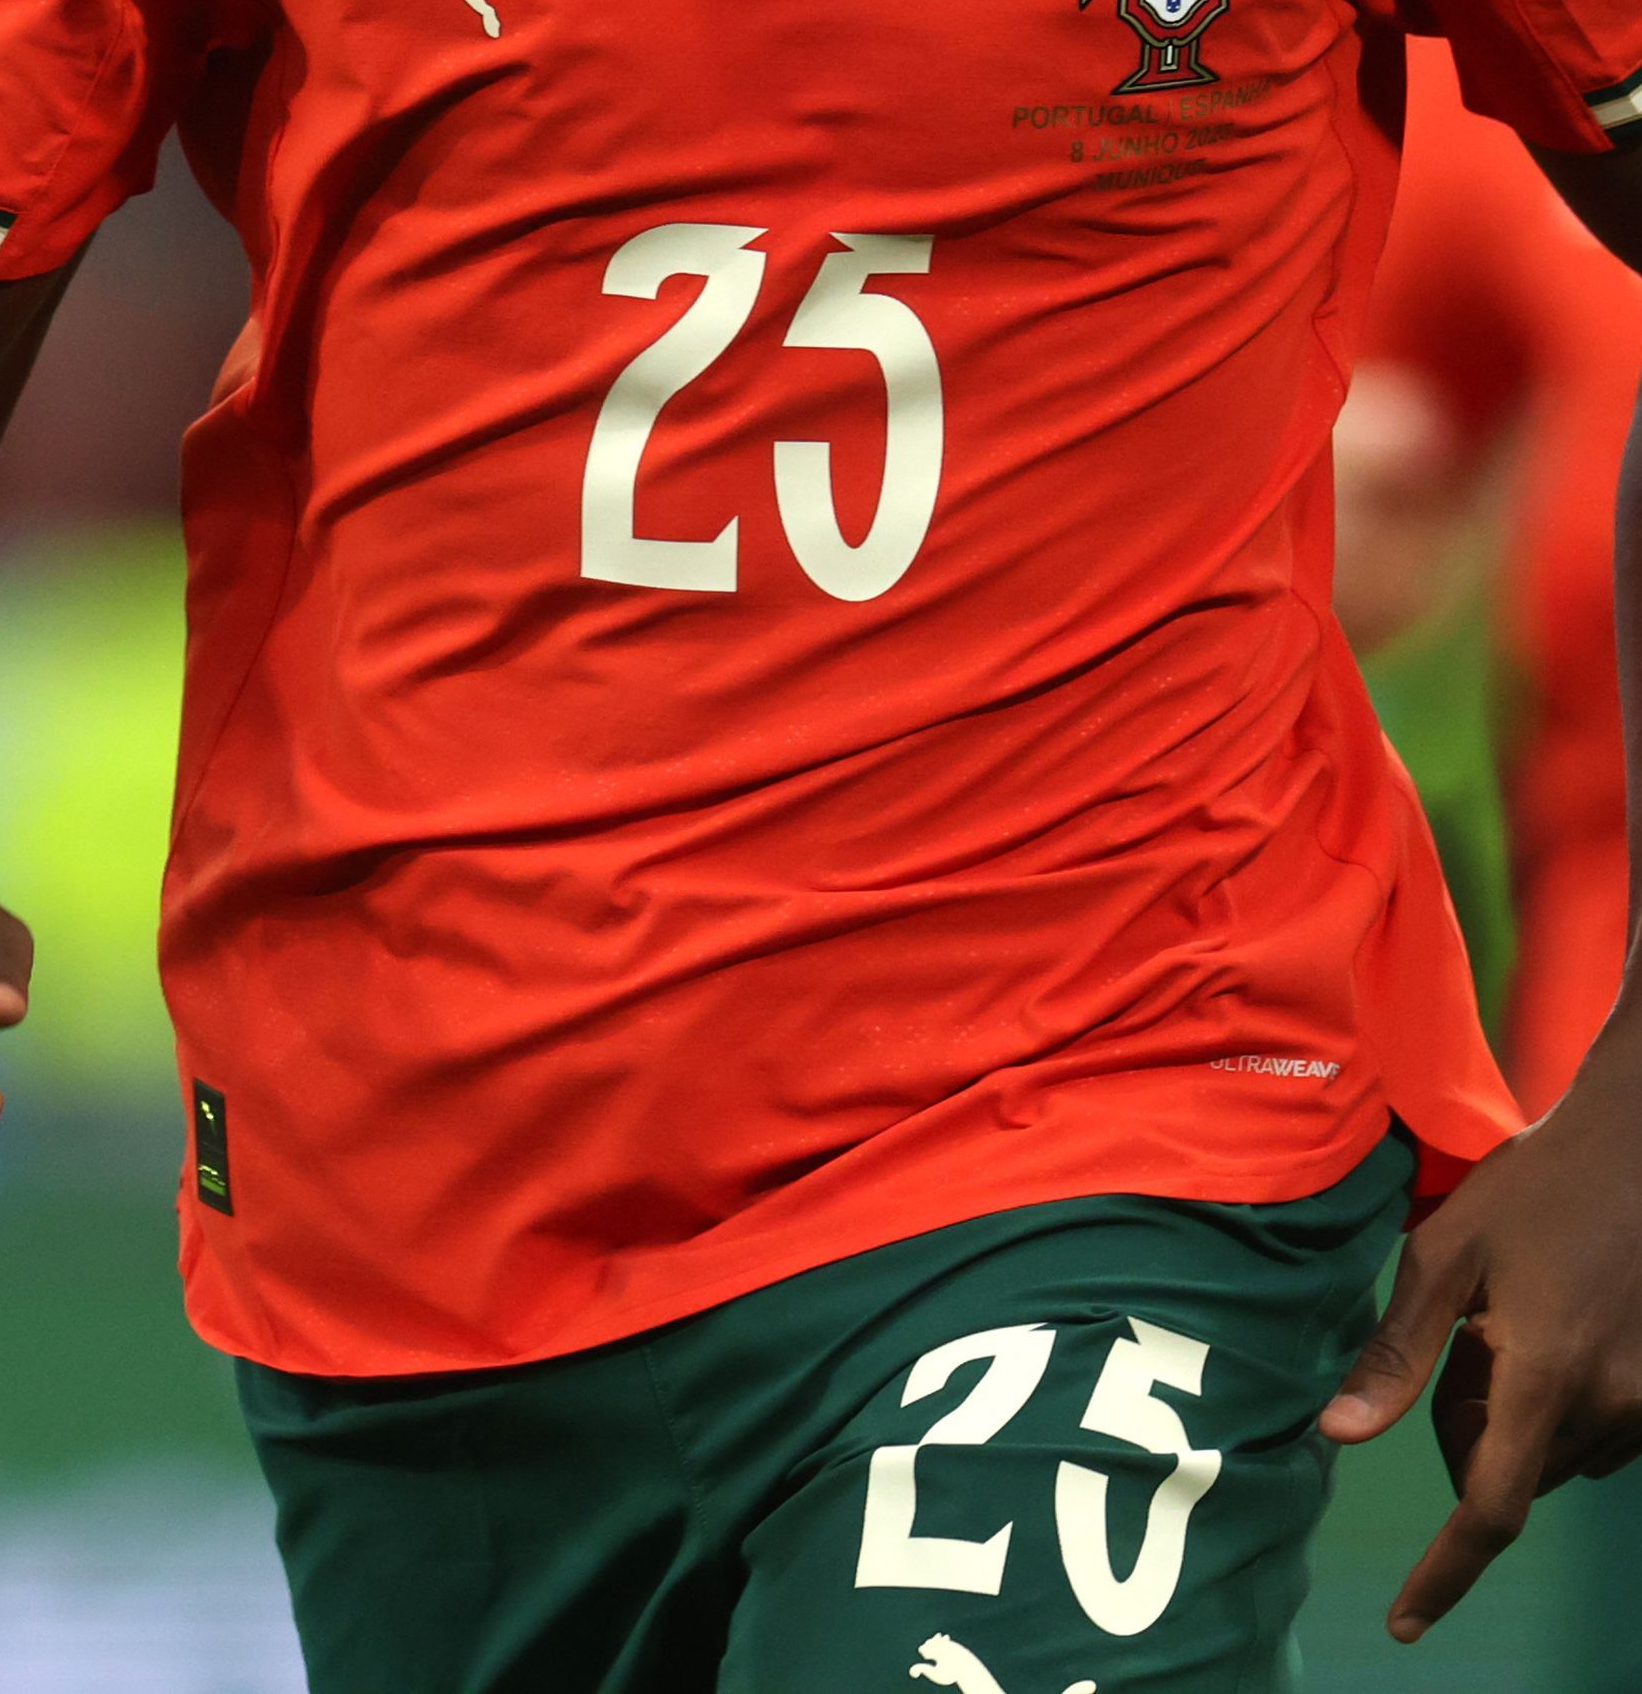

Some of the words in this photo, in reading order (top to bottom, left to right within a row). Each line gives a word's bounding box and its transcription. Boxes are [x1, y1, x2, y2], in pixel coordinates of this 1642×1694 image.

[1012, 104, 1158, 130] PORTUGAL
[1093, 131, 1179, 162] JUNHO
[580, 223, 944, 602] 25
[854, 1315, 1223, 1636] 25
